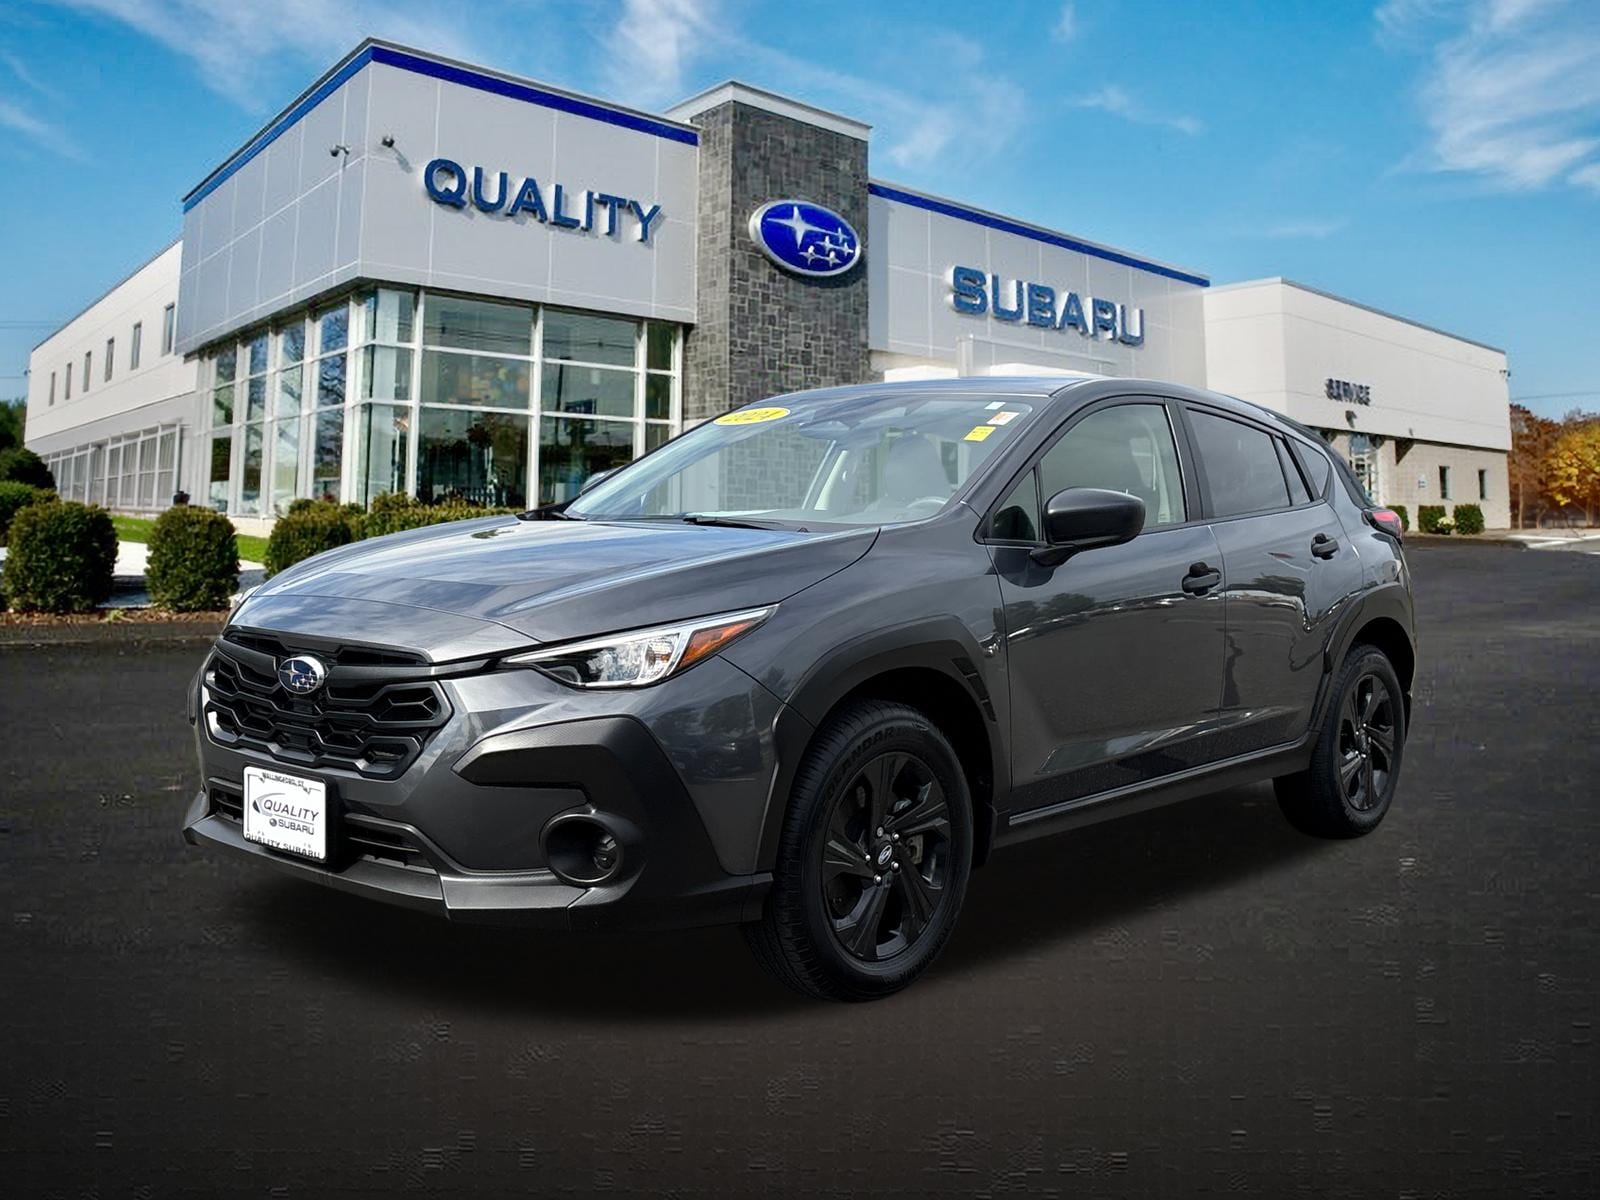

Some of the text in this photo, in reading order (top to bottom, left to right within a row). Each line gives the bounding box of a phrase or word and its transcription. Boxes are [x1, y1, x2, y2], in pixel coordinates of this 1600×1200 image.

[424, 158, 661, 242] QUALITY
[951, 265, 1145, 346] SUBARU
[264, 799, 319, 821] QUALITY
[278, 819, 314, 835] SUBARU
[245, 833, 320, 859] QUALITY SUBARU
